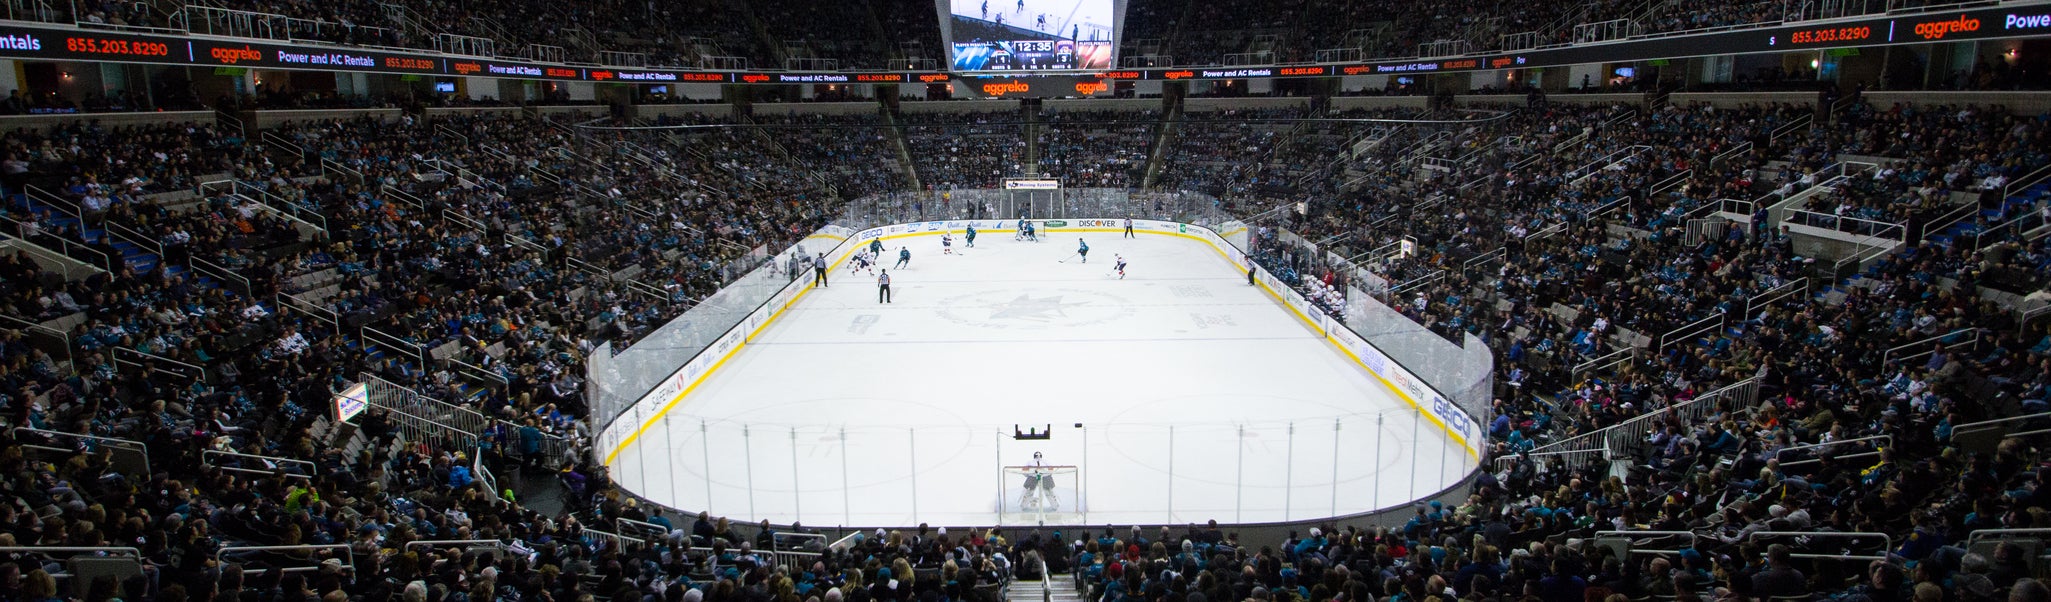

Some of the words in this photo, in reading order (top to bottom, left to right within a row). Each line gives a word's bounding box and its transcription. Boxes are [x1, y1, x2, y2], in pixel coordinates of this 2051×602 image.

[1915, 15, 1980, 39] aggreko
[2005, 14, 2051, 30] Powe
[1791, 26, 1870, 44] 855.203.8290
[67, 37, 167, 56] 855.203.8290
[1017, 42, 1052, 52] 12:35
[211, 45, 261, 63] aggreko
[278, 50, 308, 64] Power
[311, 53, 328, 65] and
[330, 54, 343, 65] AC
[345, 55, 374, 67] Rentals
[385, 58, 434, 69] 855.203.8290
[454, 61, 481, 73] aggreko
[489, 65, 506, 73] Power
[506, 66, 516, 74] and
[517, 67, 524, 75] AC
[525, 67, 542, 75] Rentals
[1164, 70, 1193, 80] aggreko
[1280, 67, 1323, 75] 855.203.8290
[1344, 65, 1370, 75] aggreko
[743, 74, 770, 82] aggreko
[919, 74, 949, 83] aggreko
[983, 80, 1029, 96] aggreko
[861, 229, 882, 239] GEICO
[1433, 396, 1470, 438] GEICO
